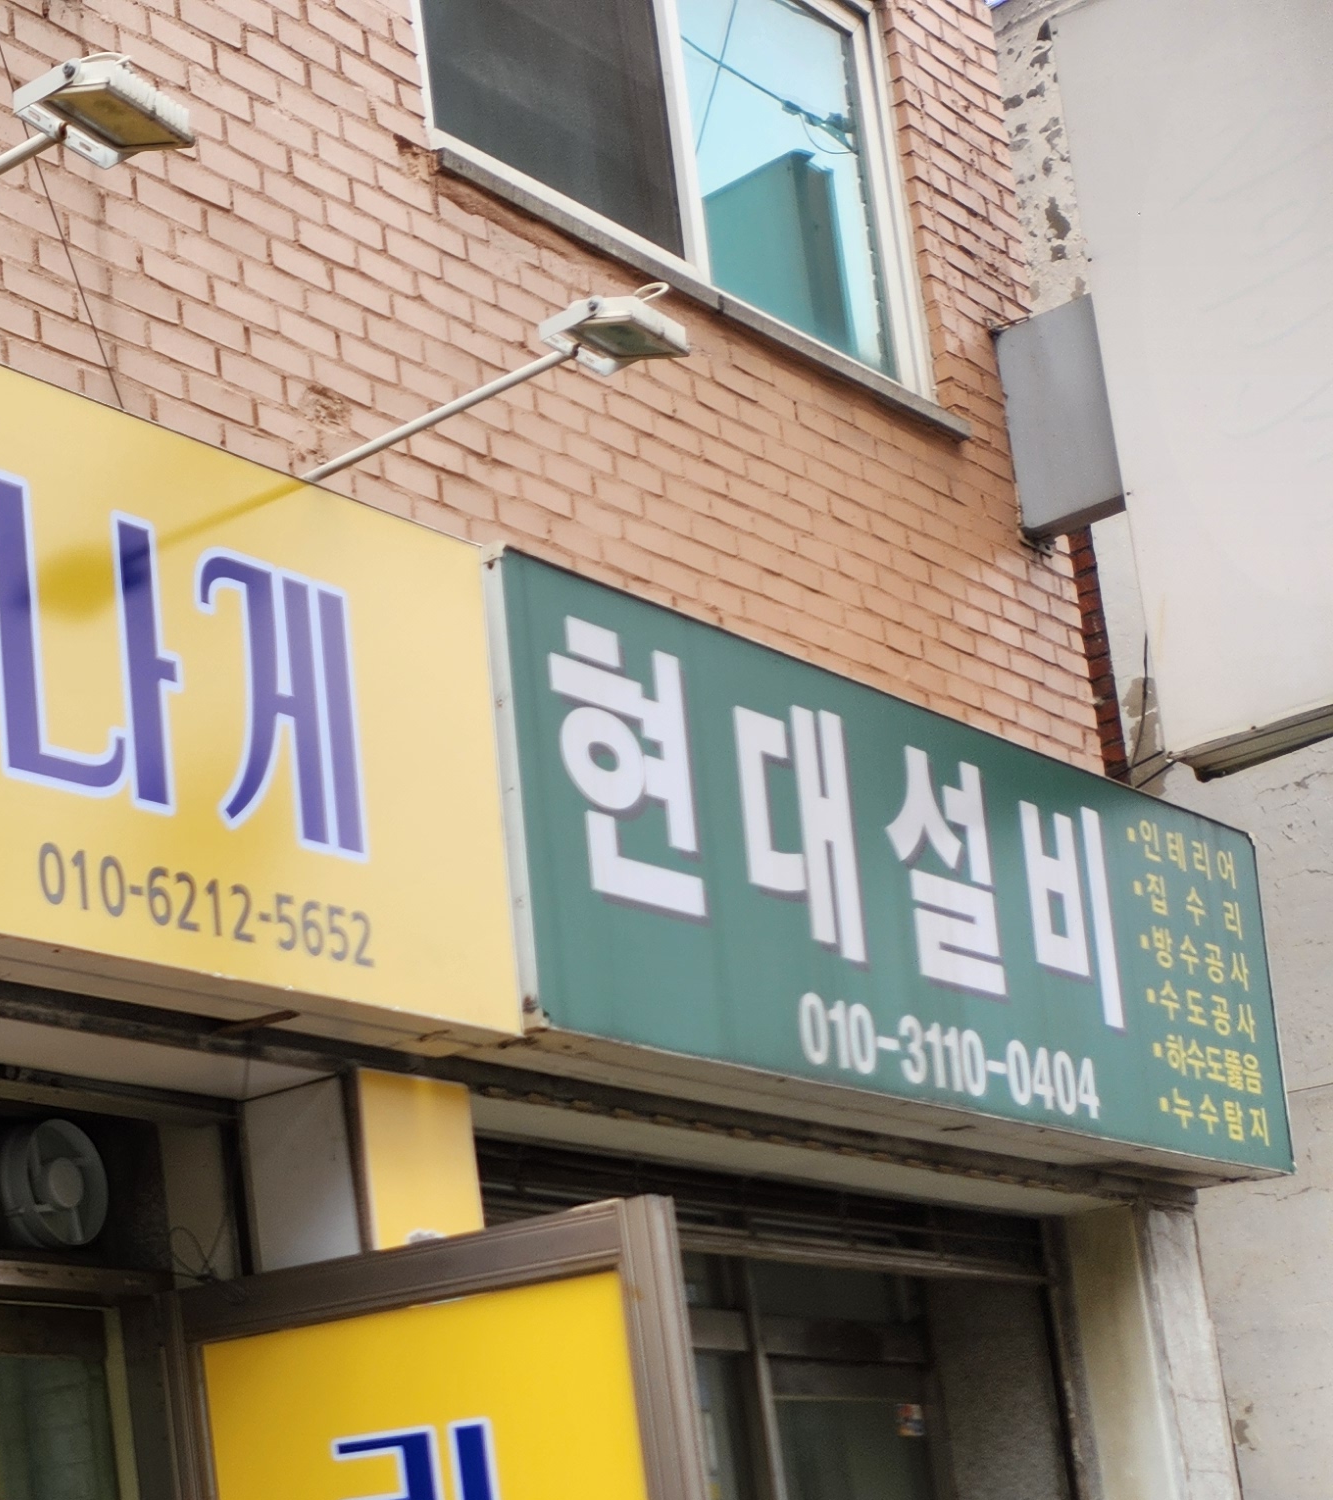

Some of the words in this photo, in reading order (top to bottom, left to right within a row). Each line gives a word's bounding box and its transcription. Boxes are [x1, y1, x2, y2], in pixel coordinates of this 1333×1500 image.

[548, 615, 1123, 1030] 현대설비
[1139, 820, 1236, 889] 인테리어
[39, 842, 374, 967] 010-6212-5652
[1152, 926, 1249, 992] 방수공사
[1160, 980, 1256, 1043] 수도공사
[799, 992, 1100, 1119] 010-3110-0404
[1173, 1087, 1270, 1147] 누수탐지
